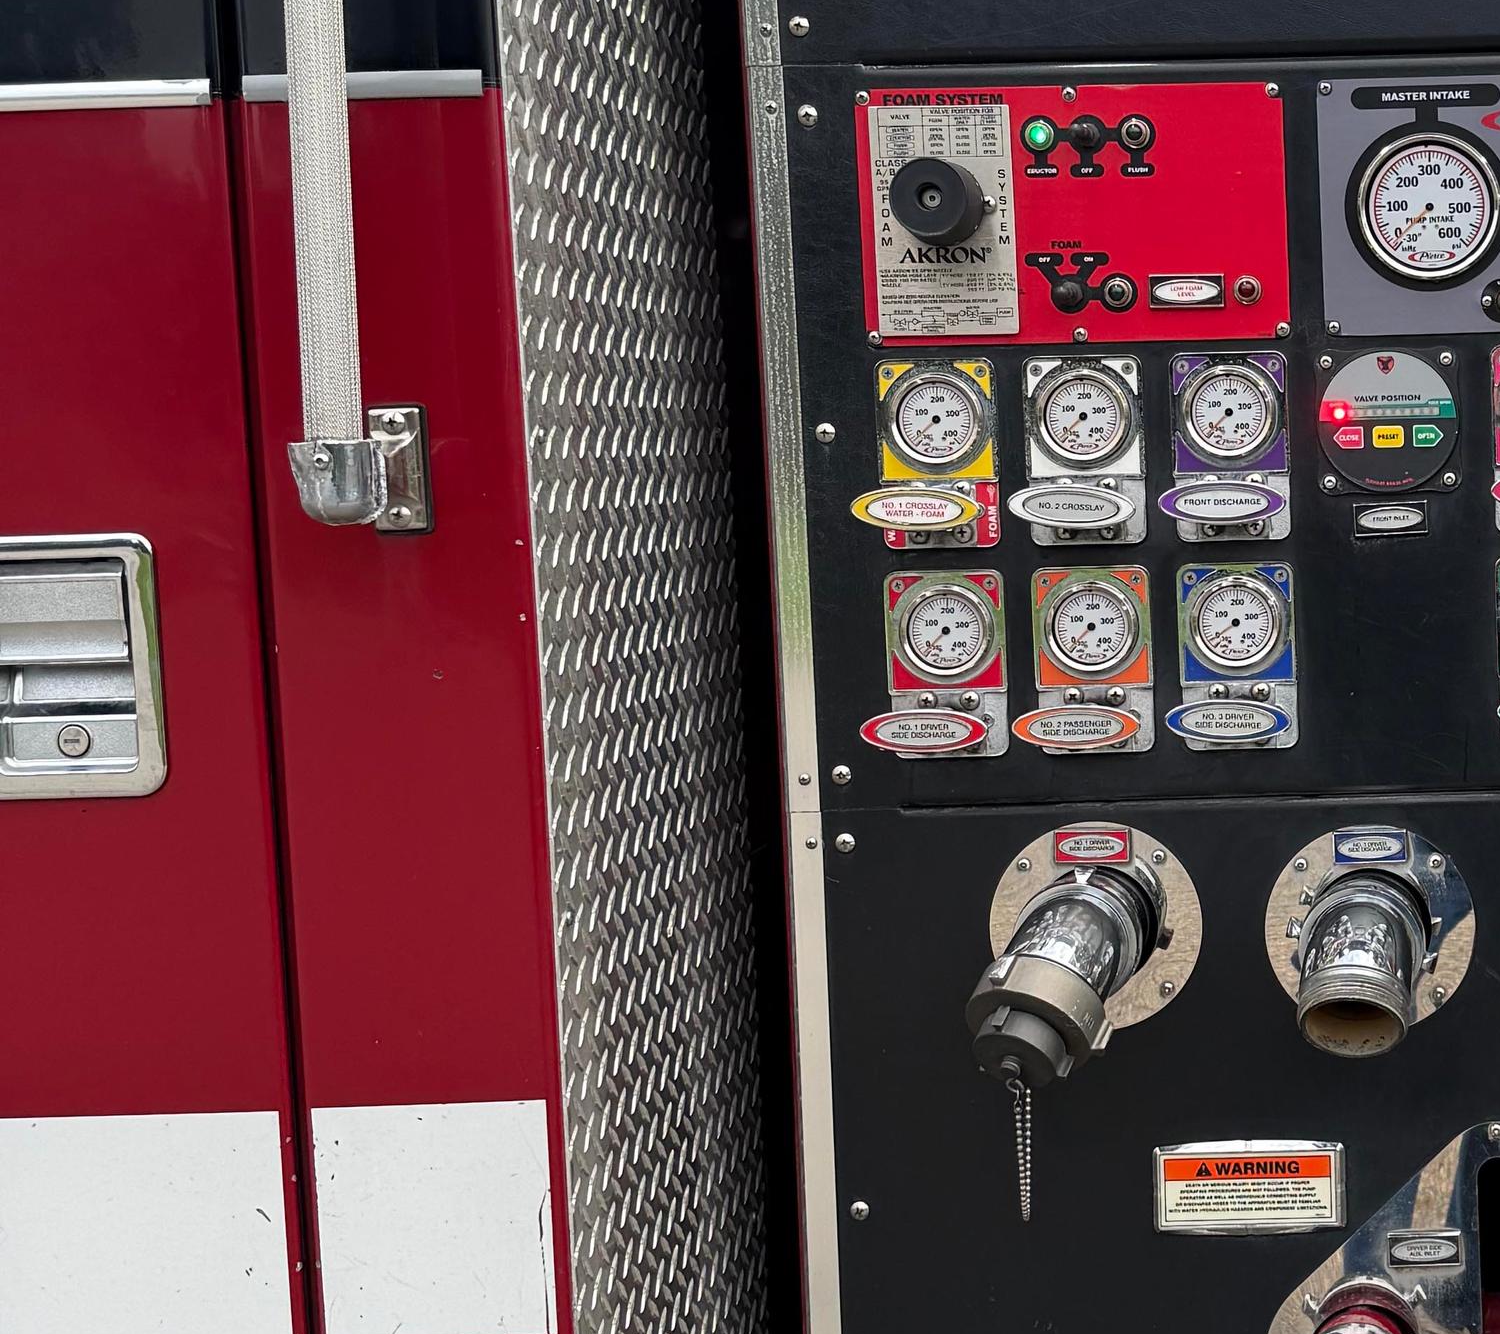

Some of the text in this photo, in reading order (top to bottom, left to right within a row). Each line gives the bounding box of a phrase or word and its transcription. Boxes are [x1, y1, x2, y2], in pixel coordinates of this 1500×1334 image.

[883, 94, 1003, 106] FOAM SYSTEM
[1381, 90, 1470, 102] MASTER INTAKE
[1417, 165, 1441, 176] 300
[1395, 176, 1419, 188] 200
[1440, 178, 1464, 190] 400
[1387, 200, 1408, 212] 100
[1448, 202, 1471, 214] 500
[1395, 228, 1401, 237] 0
[1439, 227, 1461, 238] 600
[1051, 241, 1082, 249] FOAM
[1038, 502, 1052, 510] NO.
[1062, 503, 1105, 512] CROSSLAY
[1213, 498, 1262, 506] DISCHARGE
[921, 510, 944, 518] FOAM
[989, 506, 998, 537] FOAM
[1195, 721, 1261, 729] SIDE DISCHARGE
[1215, 1161, 1300, 1175] WARNING
